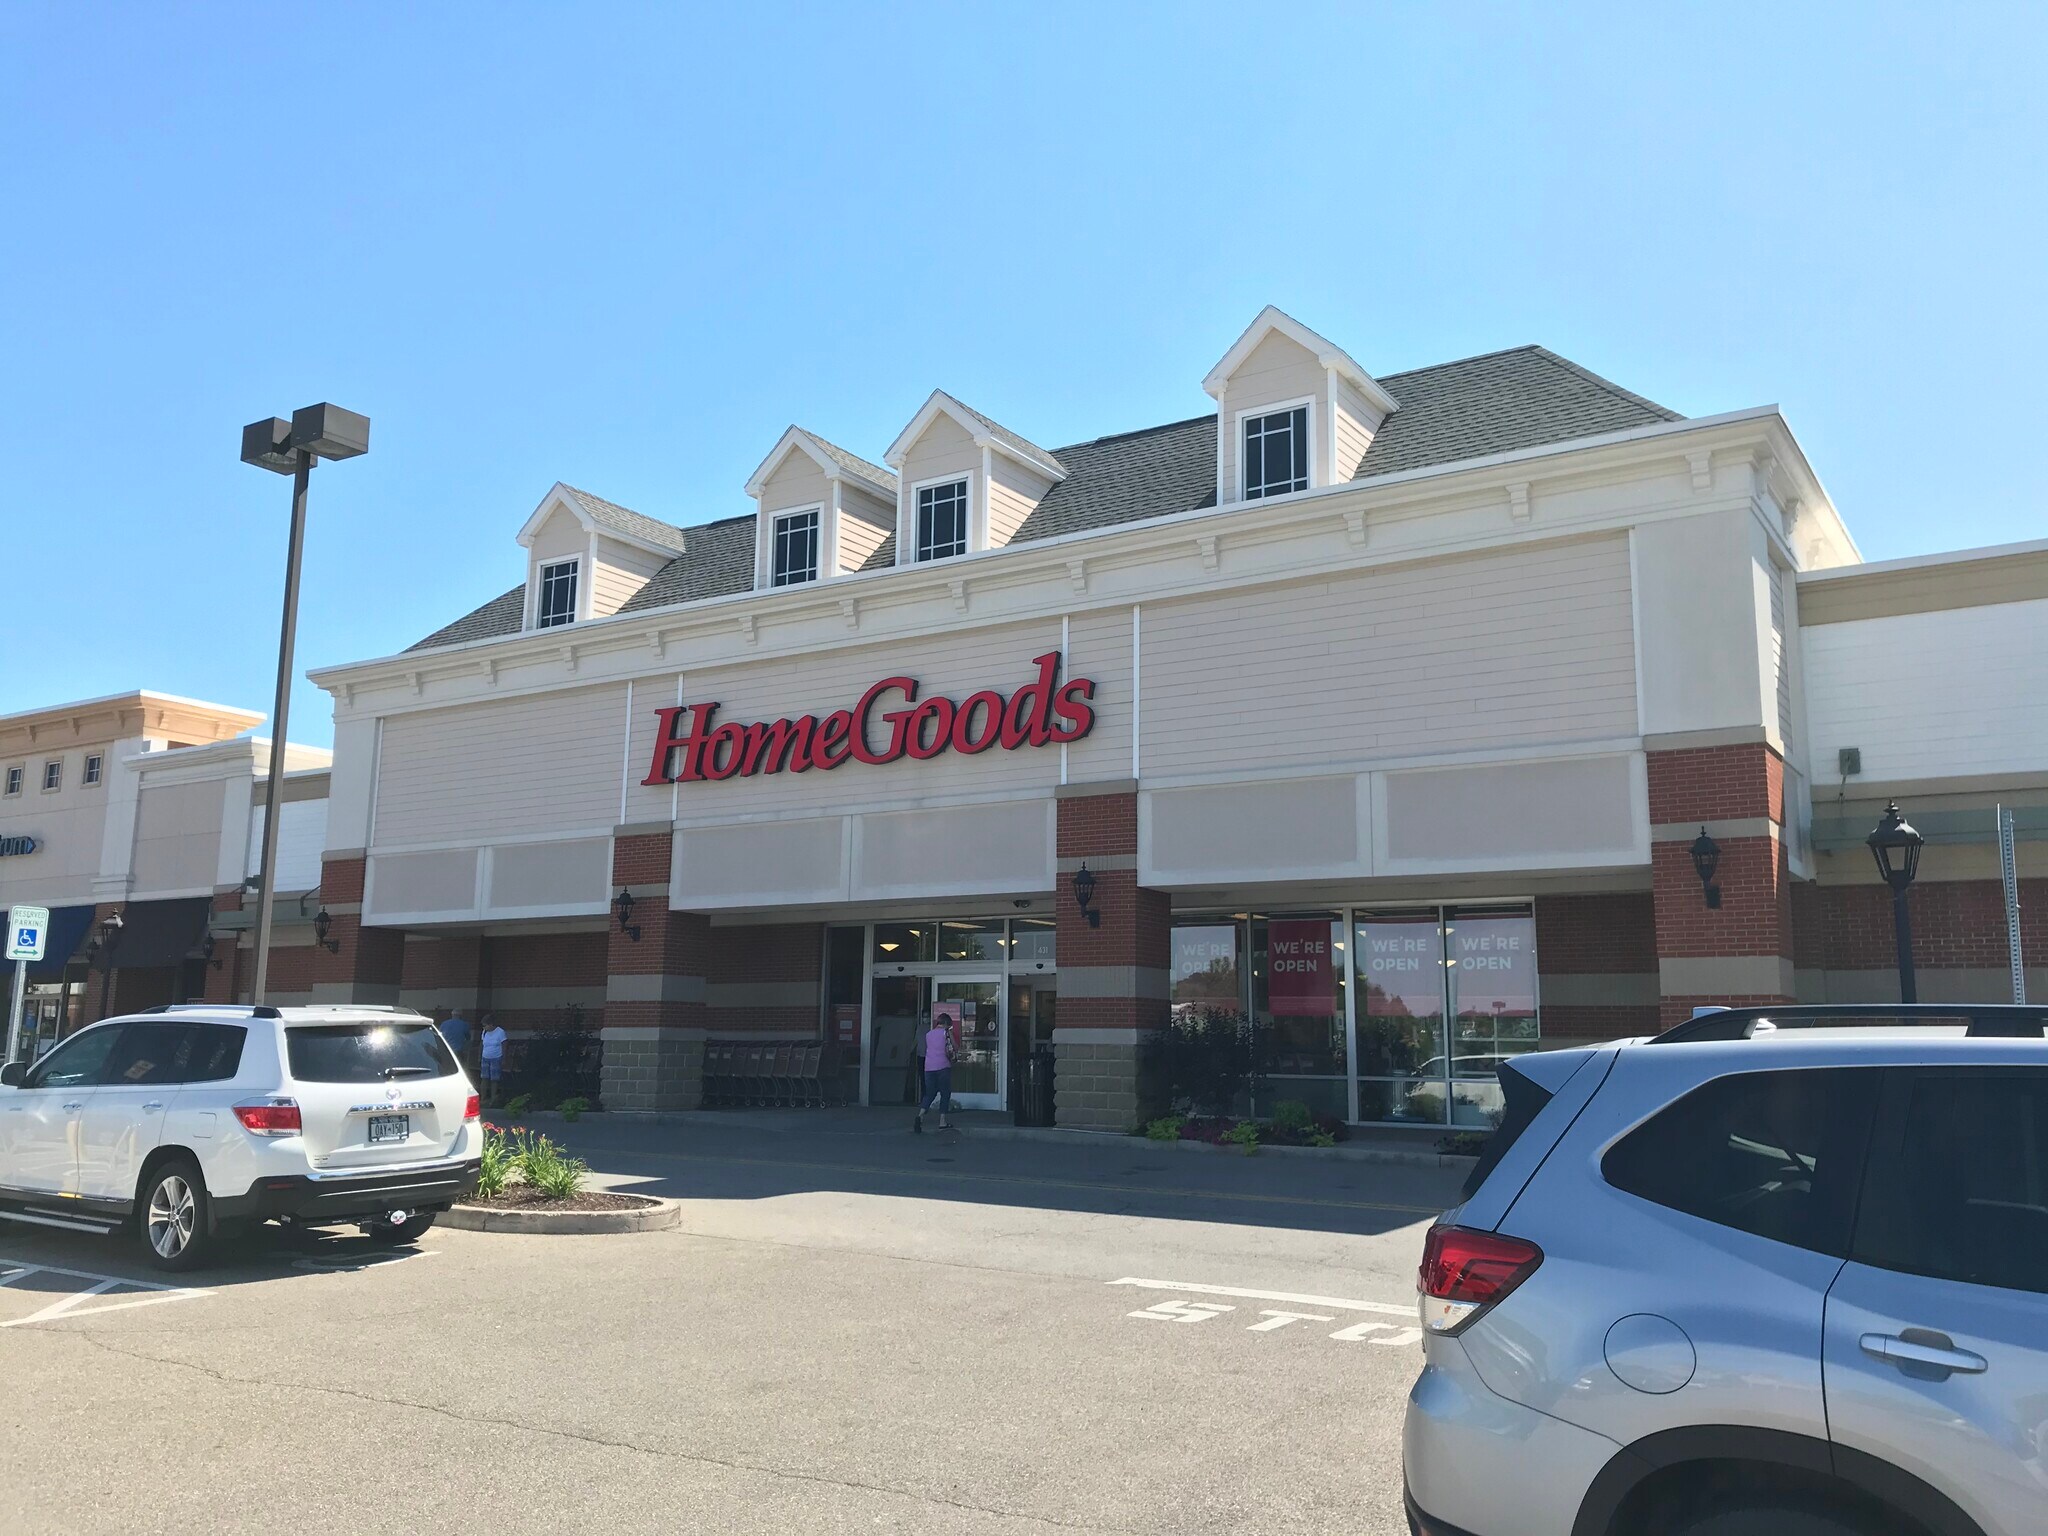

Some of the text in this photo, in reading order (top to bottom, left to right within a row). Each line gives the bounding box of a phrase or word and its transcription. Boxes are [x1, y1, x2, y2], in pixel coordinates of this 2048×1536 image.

[640, 650, 1096, 786] HomeGoods
[14, 909, 46, 919] RESERVED
[14, 918, 44, 928] PARKING
[1182, 941, 1230, 956] WE'RE
[1273, 938, 1325, 954] WE'RE
[1371, 935, 1428, 952] WE'RE
[1461, 934, 1520, 951] WE'RE
[1273, 959, 1318, 972] OPEN
[1371, 957, 1420, 971] OPEN
[1461, 956, 1512, 970] OPEN
